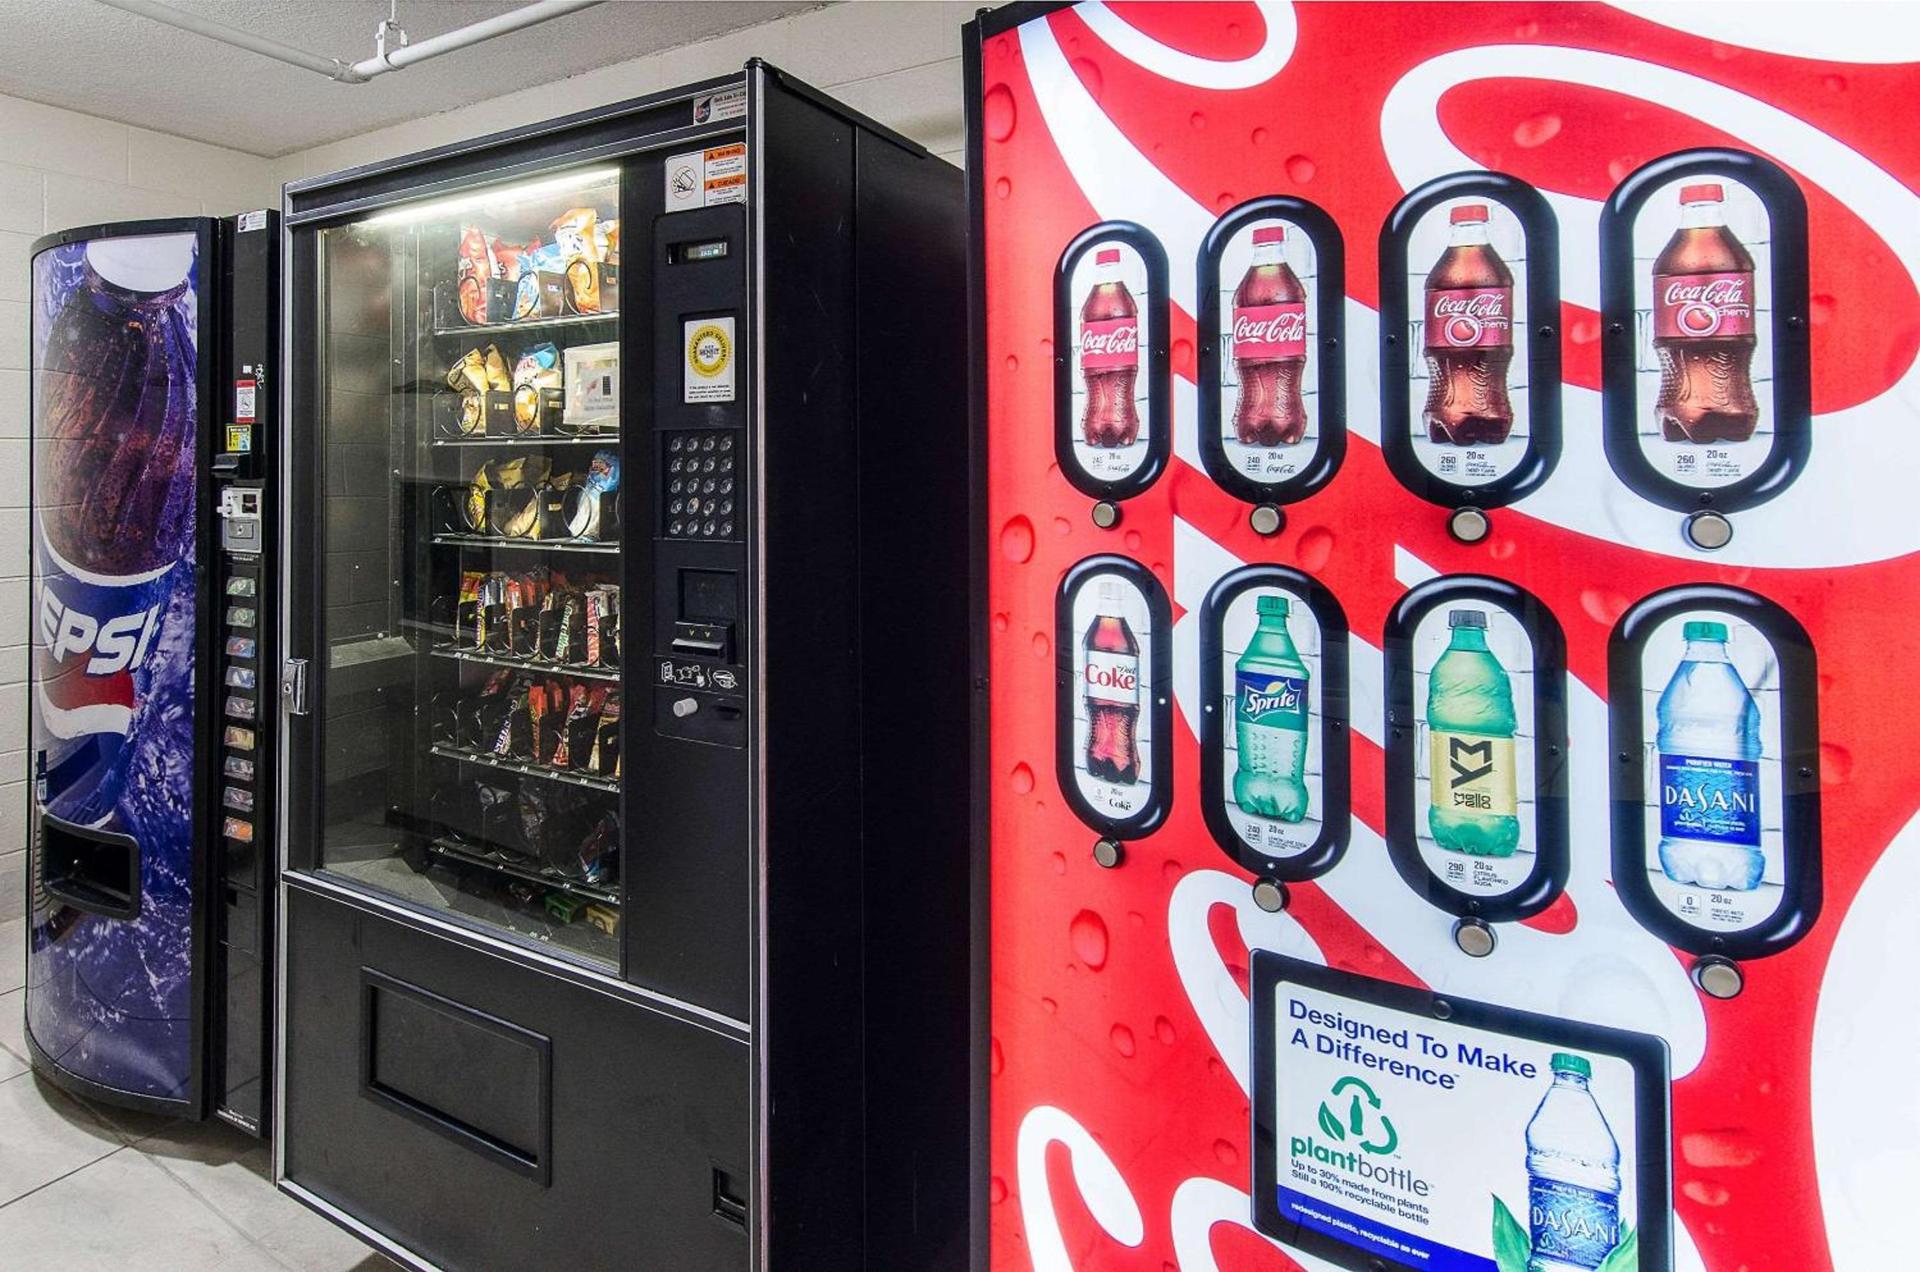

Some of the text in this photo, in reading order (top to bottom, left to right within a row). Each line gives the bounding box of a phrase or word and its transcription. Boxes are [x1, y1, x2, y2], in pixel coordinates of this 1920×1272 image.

[1665, 279, 1744, 305] Coca-Cola
[1434, 293, 1504, 318] Coca-Cola
[1082, 326, 1137, 355] Coca-Cola
[1234, 312, 1306, 344] Coca-Cola
[1441, 456, 1456, 464] 260
[1466, 451, 1476, 460] 20
[1677, 455, 1695, 464] 260
[1706, 450, 1717, 459] 20
[1085, 663, 1137, 690] Coke
[1246, 689, 1295, 715] Sprite
[1665, 783, 1754, 813] DASANI
[1448, 862, 1464, 872] 290
[1474, 861, 1484, 870] 20
[1686, 896, 1693, 905] 0
[1711, 894, 1722, 903] 20
[1289, 998, 1537, 1079] Designed To Make
[1291, 1028, 1456, 1089] A Difference
[1291, 1159, 1429, 1214] Up to 30% made from plants
[1291, 1169, 1309, 1182] Still
[1320, 1179, 1343, 1195] 100%
[1345, 1190, 1396, 1214] recyclable
[1398, 1207, 1429, 1225] bottle
[1291, 1203, 1430, 1260] redesigned plastic, recyclable as ever
[1533, 1206, 1616, 1245] DASANI
